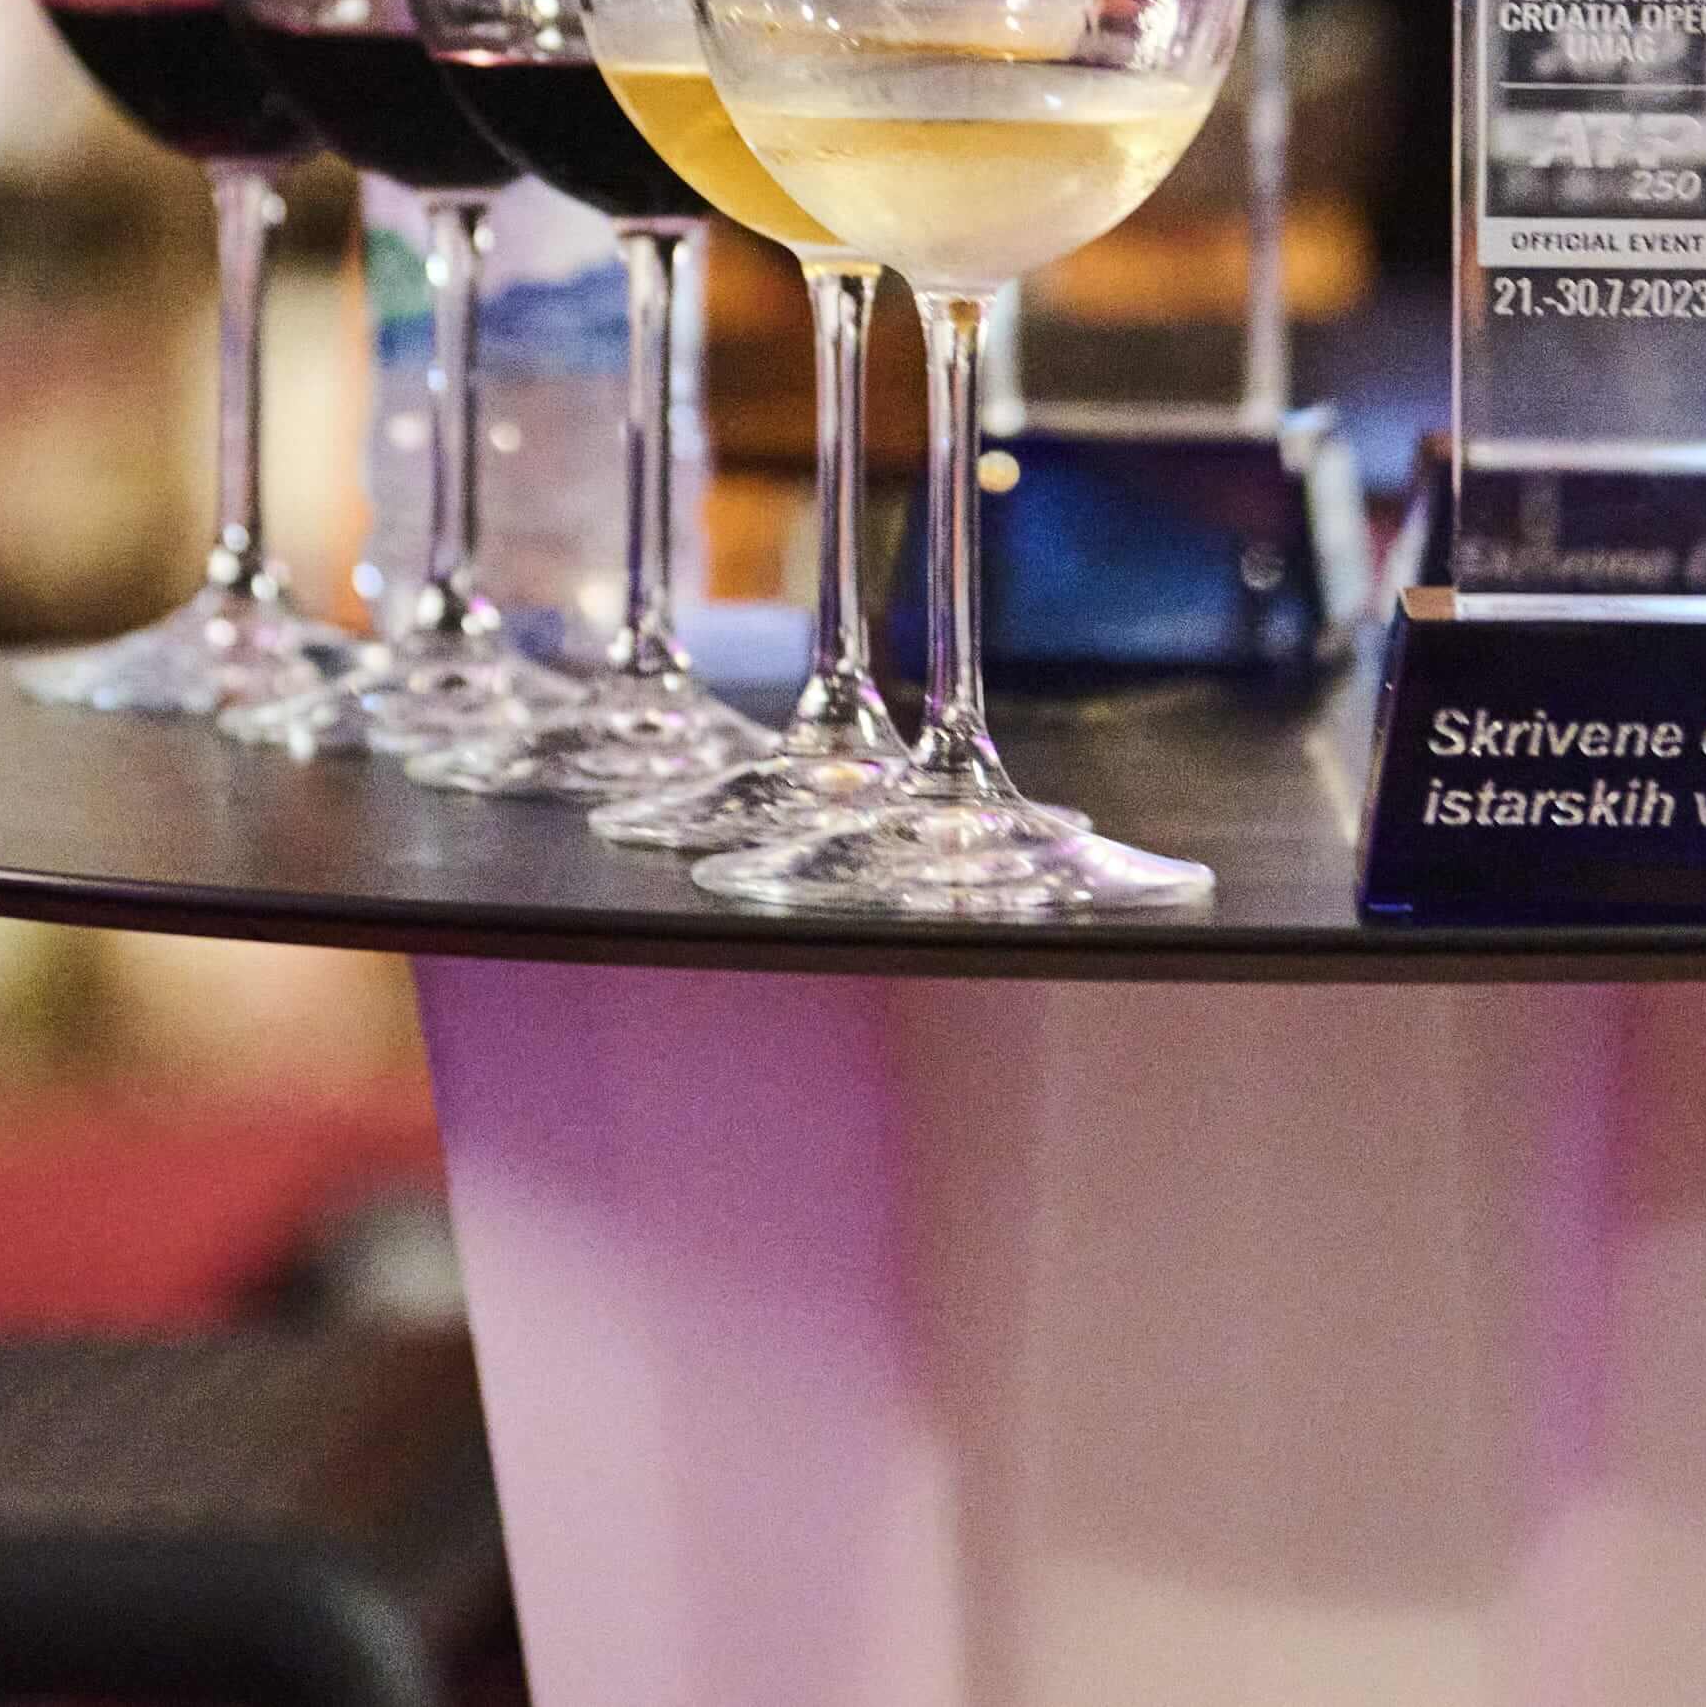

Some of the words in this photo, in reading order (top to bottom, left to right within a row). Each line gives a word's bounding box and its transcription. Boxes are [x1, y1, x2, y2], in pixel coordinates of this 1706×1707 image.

[1499, 2, 1634, 32] CROATIA
[1630, 170, 1701, 200] 250
[1512, 232, 1618, 253] OFFICIAL
[1630, 235, 1705, 255] EVENT
[1427, 709, 1684, 758] Skrivene
[1423, 778, 1675, 828] istarskih
